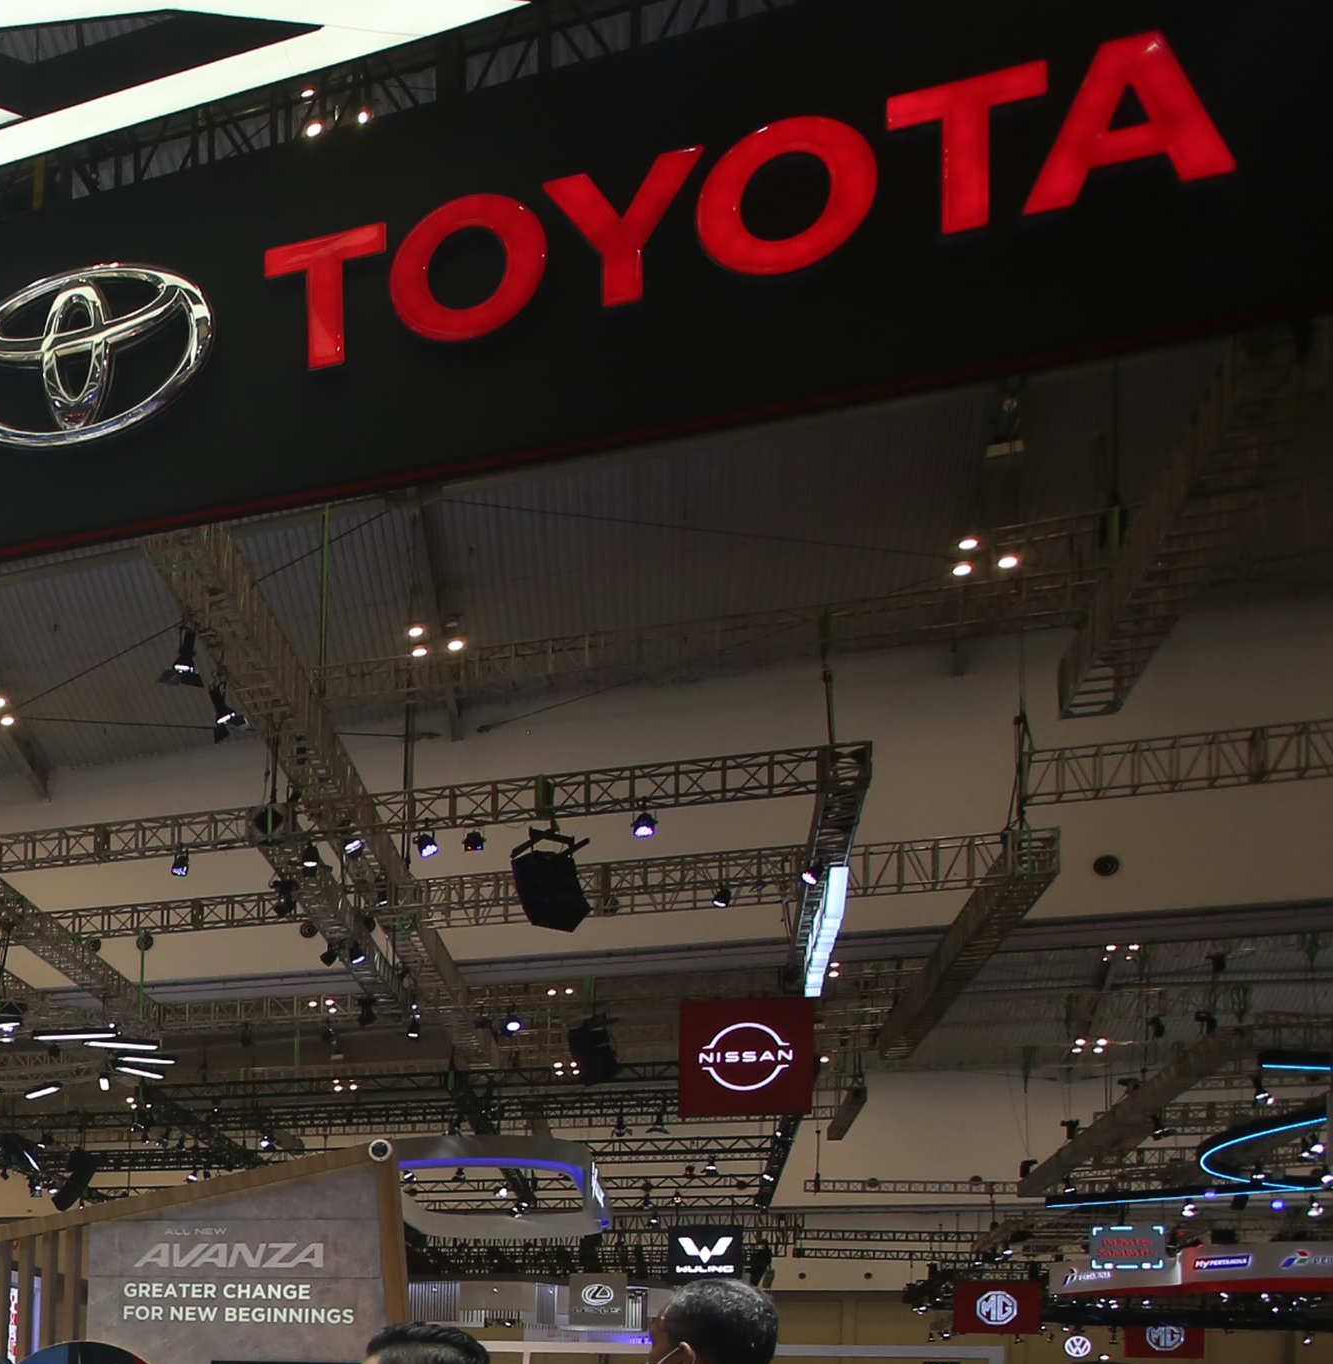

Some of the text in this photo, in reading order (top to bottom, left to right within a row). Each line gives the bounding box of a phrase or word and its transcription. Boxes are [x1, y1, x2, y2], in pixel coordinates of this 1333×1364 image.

[263, 29, 1237, 371] TOYOTA
[698, 1049, 794, 1064] NISSAN
[164, 1227, 227, 1236] ALL NEW
[134, 1243, 324, 1268] AVANZA
[675, 1265, 735, 1274] WULING
[123, 1282, 311, 1300] GREATER CHANGE
[122, 1306, 355, 1325] FOR NEW BEGINNINGS
[979, 1293, 1015, 1322] MG
[1149, 1327, 1182, 1349] MG
